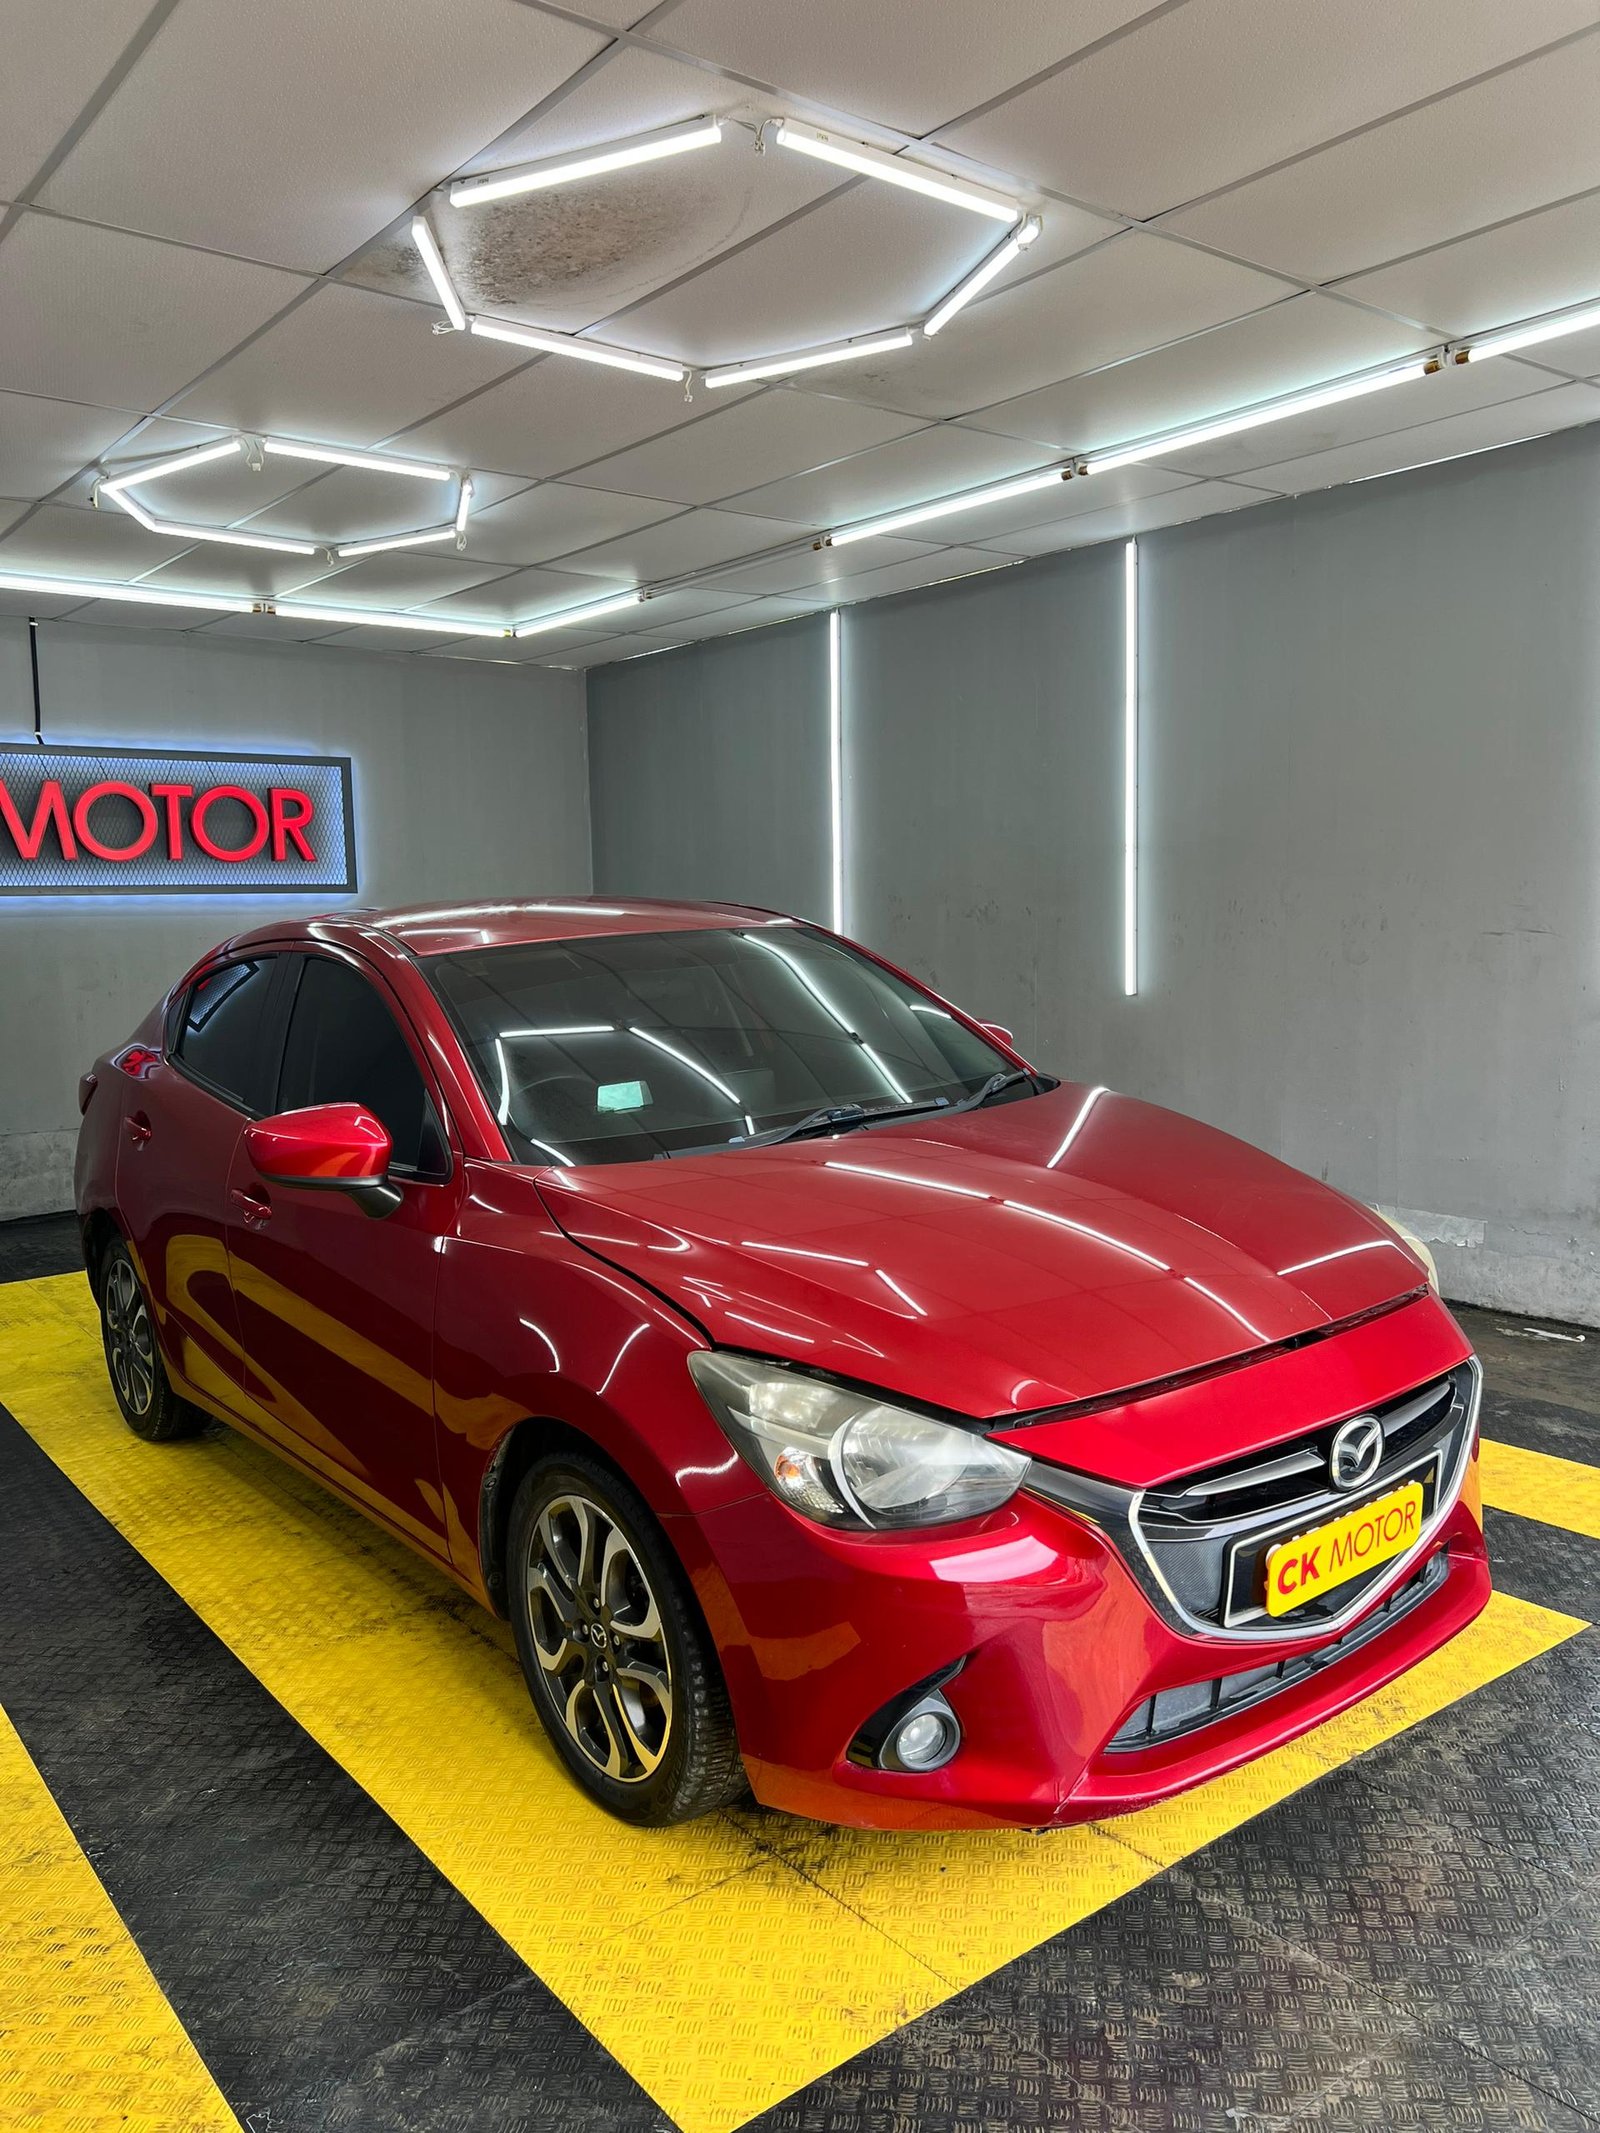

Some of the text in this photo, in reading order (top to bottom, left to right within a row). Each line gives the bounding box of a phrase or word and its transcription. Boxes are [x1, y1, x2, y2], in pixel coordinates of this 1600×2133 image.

[0, 778, 317, 863] MOTOR
[1277, 1500, 1416, 1595] CK MOTOR
